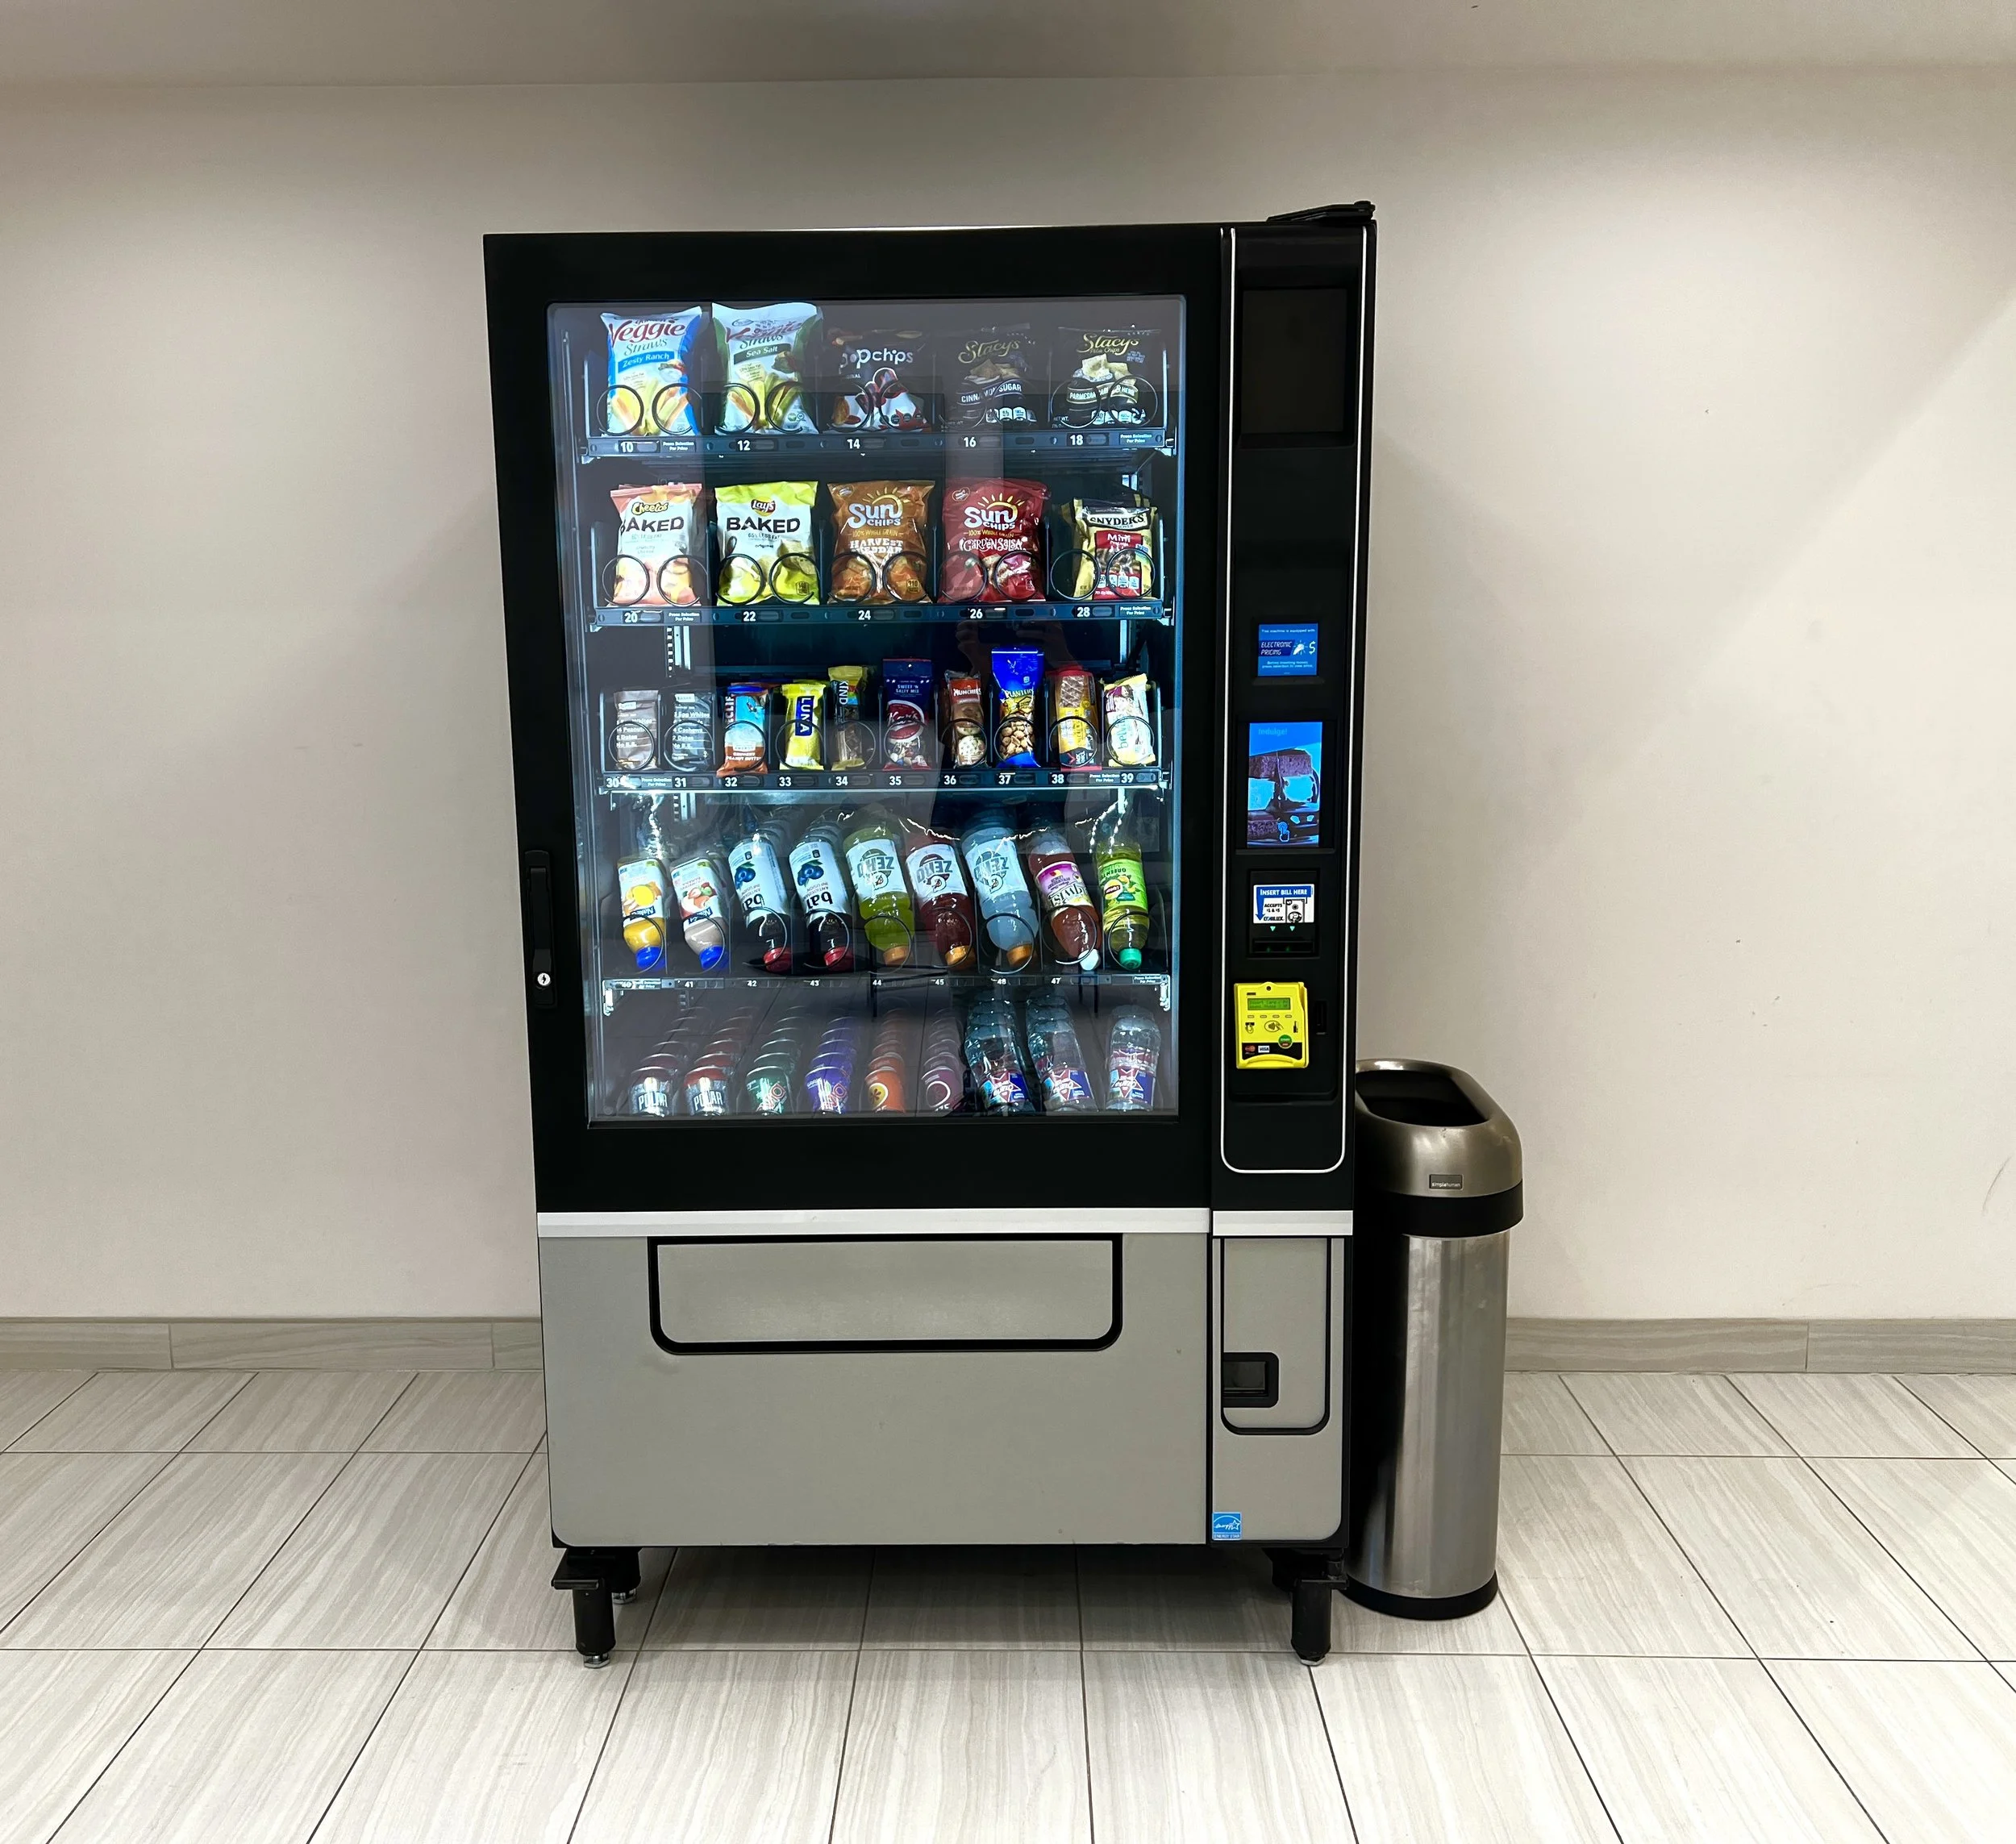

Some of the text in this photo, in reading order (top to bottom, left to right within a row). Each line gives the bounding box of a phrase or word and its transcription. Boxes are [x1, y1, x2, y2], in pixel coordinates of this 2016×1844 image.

[609, 319, 685, 348] Veggie
[624, 339, 668, 356] Straws
[746, 346, 778, 358] Sea Salt
[623, 352, 670, 368] Zesty Ranch
[998, 383, 1022, 393] SUGAR
[737, 439, 750, 451] 12
[848, 439, 860, 449] 14
[964, 436, 977, 447] 16
[1070, 435, 1084, 446] 18
[620, 441, 634, 452] 10
[631, 502, 669, 515] Cheetos
[848, 500, 903, 529] Sun
[964, 505, 1018, 528] Sun
[727, 516, 801, 533] BAKED
[866, 518, 901, 527] CHIPS
[983, 522, 1015, 531] CHIPS
[849, 538, 903, 549] HARVEST
[625, 612, 638, 623] 20
[744, 611, 756, 622] 22
[858, 610, 871, 620] 24
[970, 608, 983, 619] 26
[1077, 606, 1090, 618] 28
[837, 680, 849, 705] KIND
[952, 688, 982, 697] MUNCHIES
[800, 697, 811, 733] LUNA
[1258, 728, 1288, 737] Indulge!
[606, 777, 619, 788] 30
[674, 777, 686, 787] 31
[725, 777, 738, 787] 32
[779, 776, 792, 787] 33
[835, 776, 848, 786] 34
[889, 776, 902, 786] 35
[943, 776, 956, 785] 36
[998, 775, 1011, 785] 37
[1052, 773, 1064, 784] 38
[1121, 772, 1134, 784] 39
[917, 860, 953, 884] ZERO
[694, 1091, 723, 1111] POLAR
